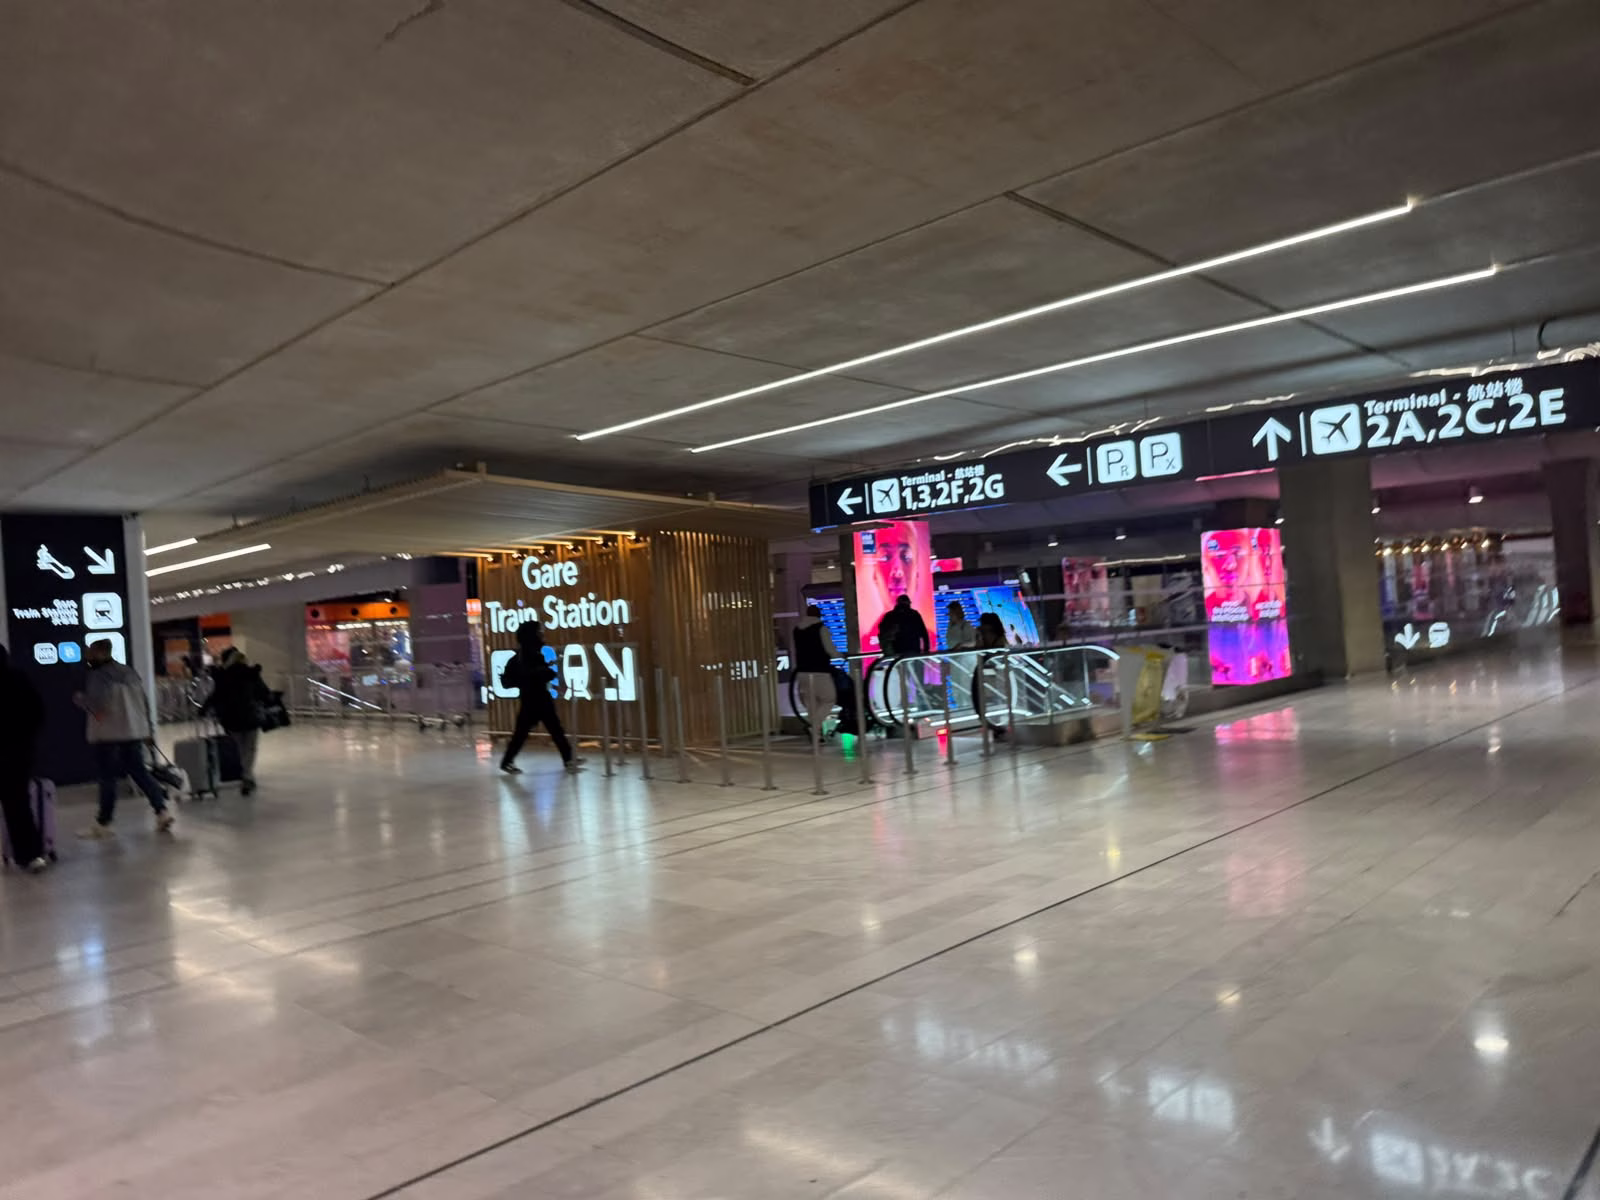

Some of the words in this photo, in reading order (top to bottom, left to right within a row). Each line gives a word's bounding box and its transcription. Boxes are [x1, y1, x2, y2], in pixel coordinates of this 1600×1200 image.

[1364, 388, 1447, 416] Terminal
[1367, 388, 1567, 448] 2A,2C,2E
[900, 470, 945, 487] Terminal
[901, 474, 1004, 511] 1,3,2F,2G
[521, 555, 579, 590] Gare
[485, 599, 538, 633] Train
[543, 592, 630, 630] Station
